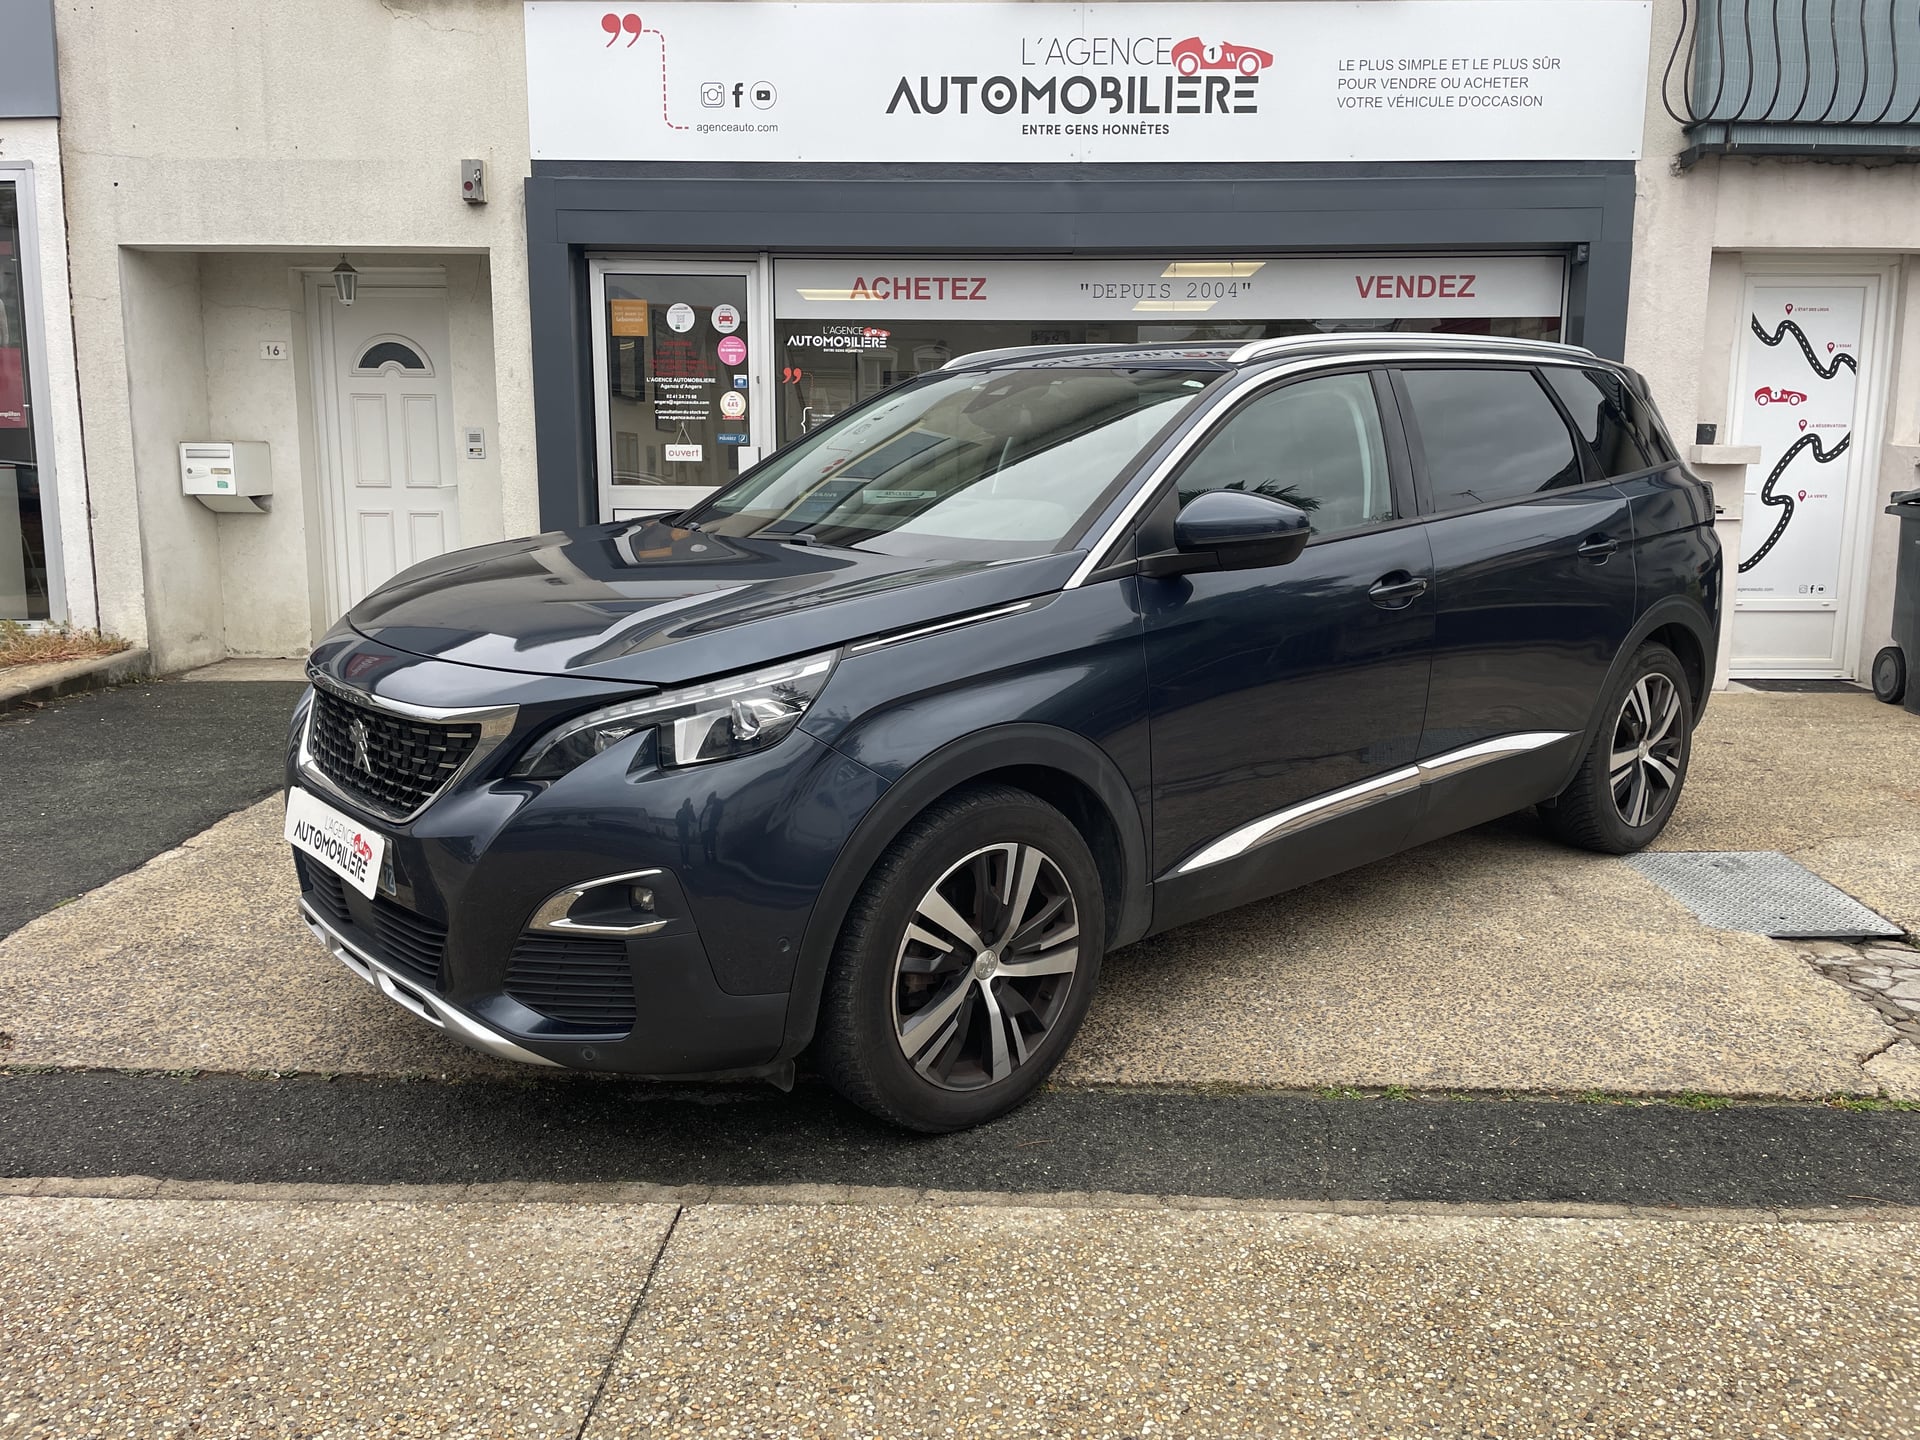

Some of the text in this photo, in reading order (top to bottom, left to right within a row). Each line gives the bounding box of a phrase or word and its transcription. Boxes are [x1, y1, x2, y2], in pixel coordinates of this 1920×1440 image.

[1021, 37, 1172, 66] L'AGENCE
[1208, 46, 1216, 60] 1
[1339, 55, 1561, 71] LE PLUS SIMPLE ET LE PLUS SÛR
[1338, 76, 1529, 89] POUR VENDRE OU ACHETER
[1337, 93, 1543, 108] VOTRE VÉHICULE D'OCCASION
[696, 123, 779, 134] agenceauto.com
[1022, 121, 1170, 135] ENTRE GENS HONNÊTES
[849, 276, 987, 300] ACHETEZ
[1080, 282, 1252, 299] "DEPUIS 2004"
[1355, 274, 1477, 298] VENDEZ
[822, 326, 864, 335] L'AGENCE
[266, 345, 280, 356] 16
[668, 449, 699, 457] ouvert
